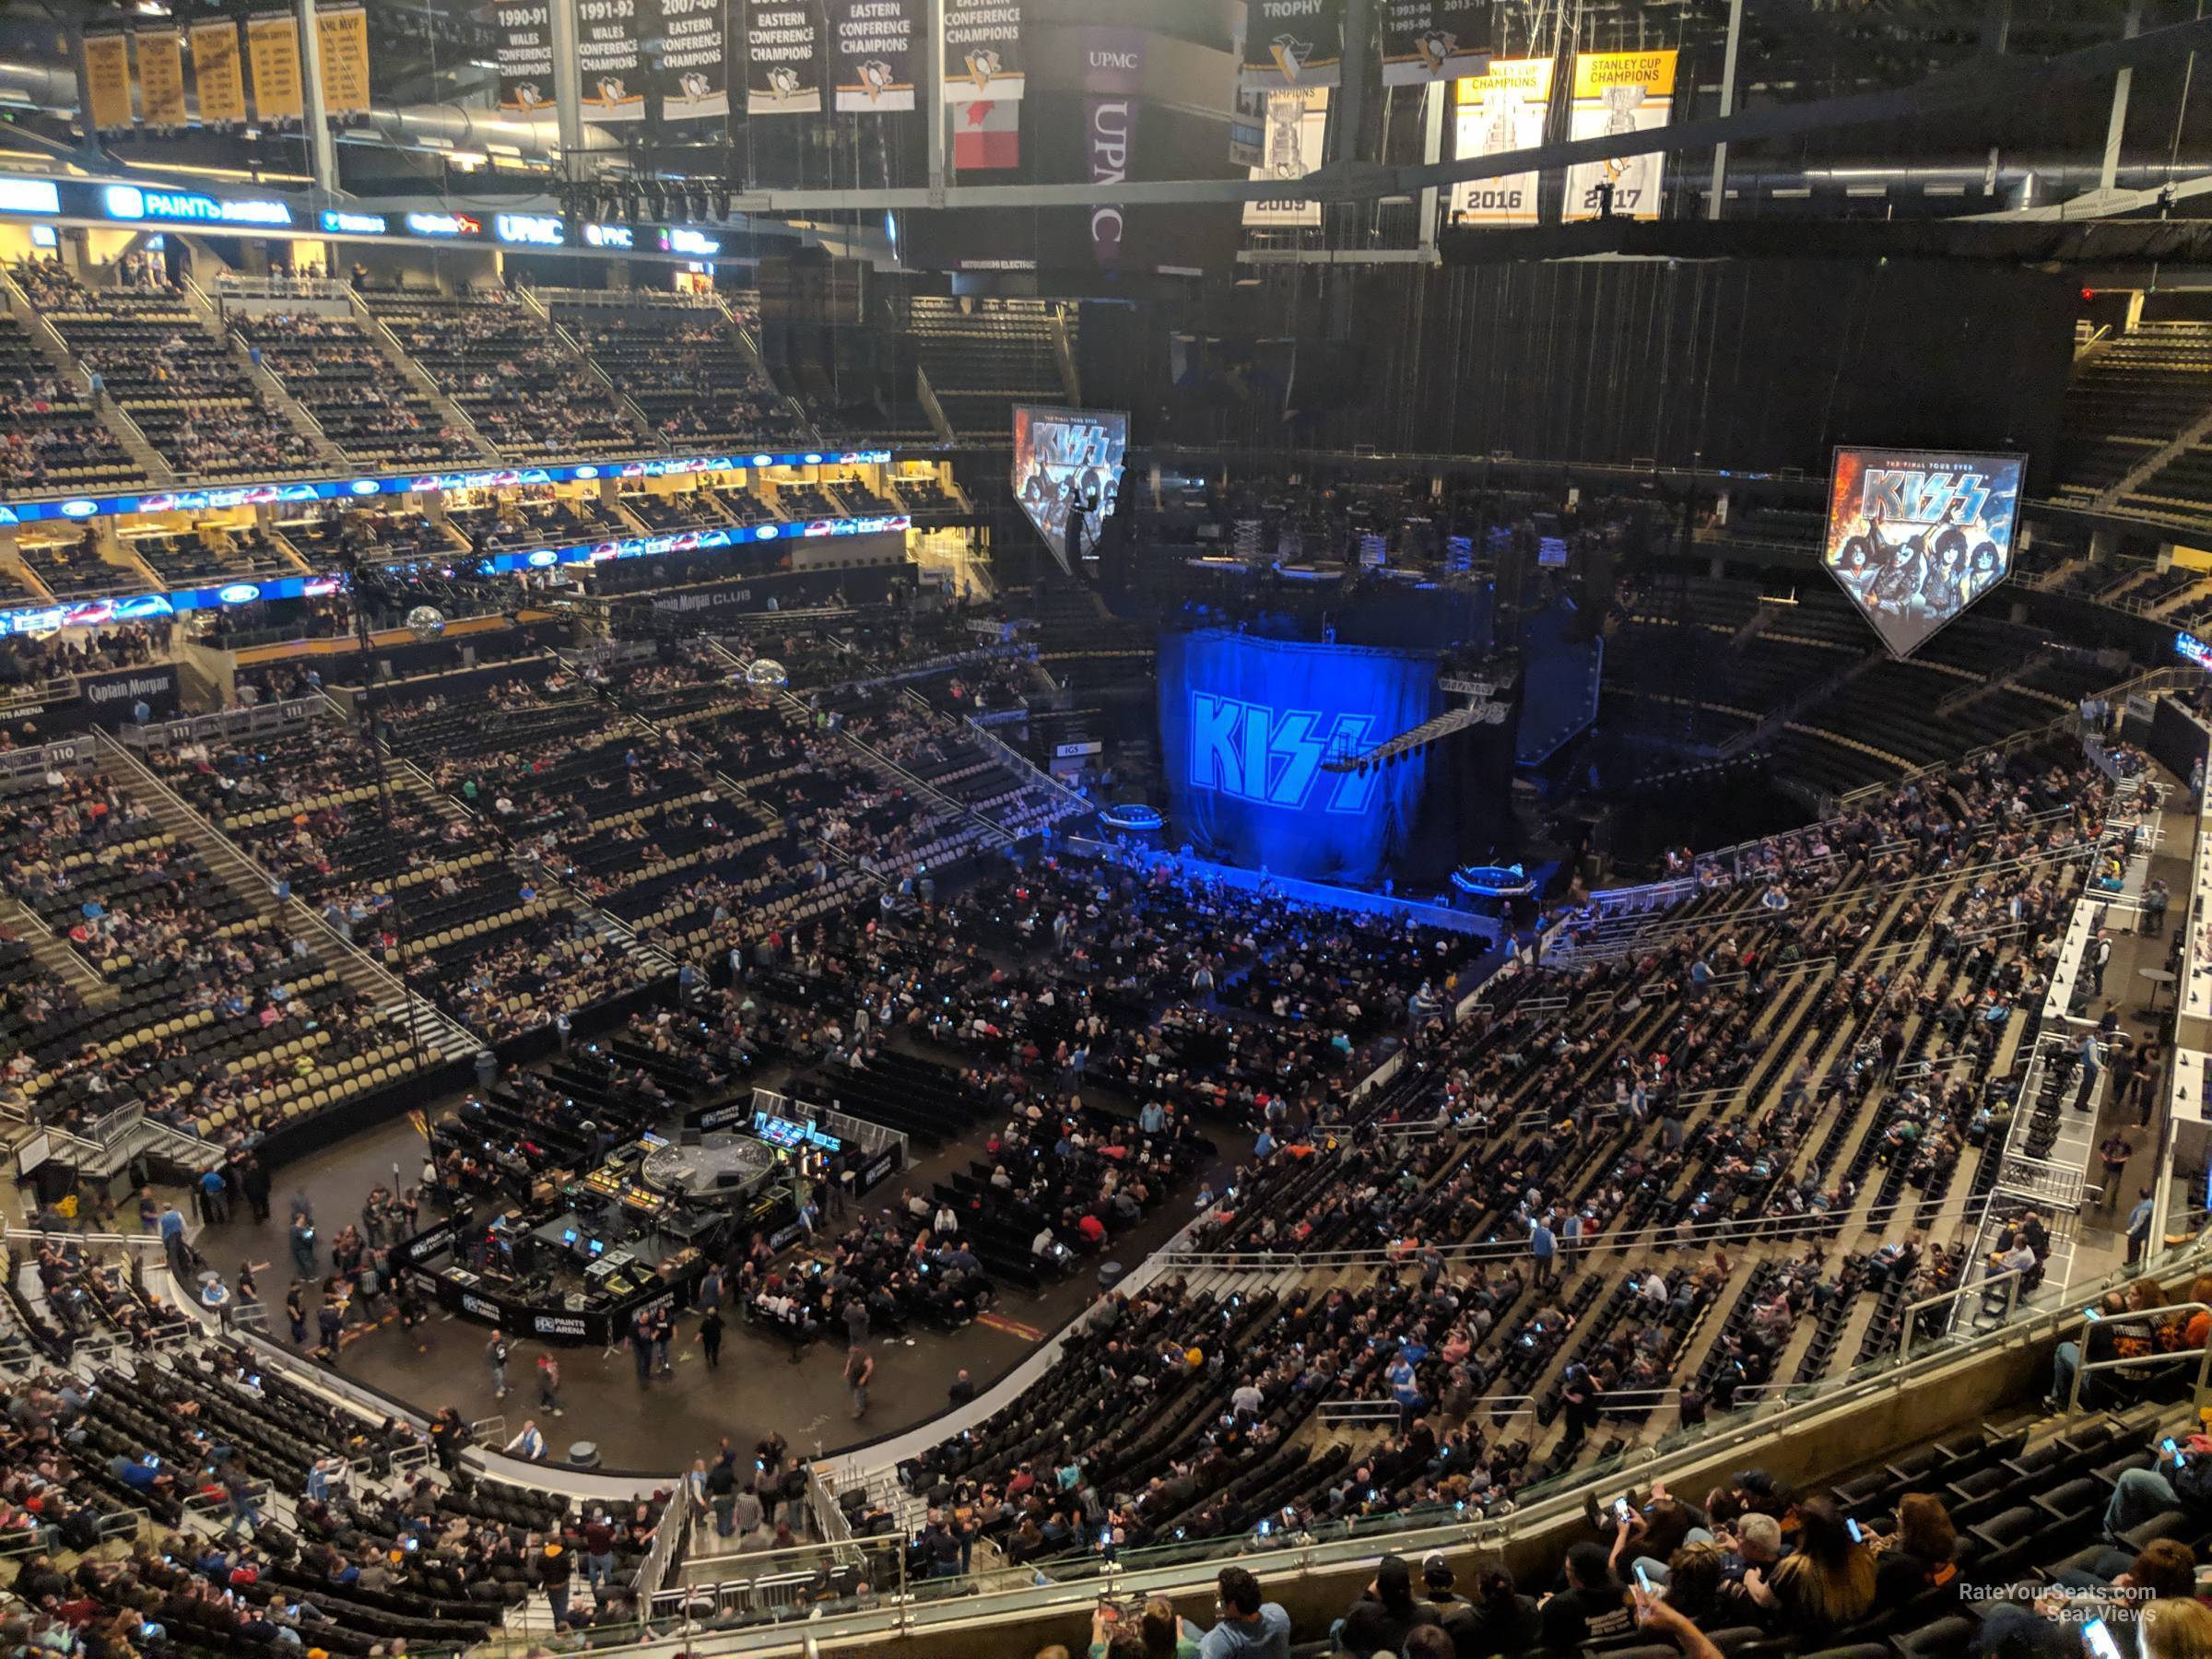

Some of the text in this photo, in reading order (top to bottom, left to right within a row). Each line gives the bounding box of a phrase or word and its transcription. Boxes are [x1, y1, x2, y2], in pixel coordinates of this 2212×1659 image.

[498, 7, 547, 27] 1990-91
[580, 1, 635, 20] 1991-92
[850, 3, 900, 18] EASTERN
[944, 7, 1020, 27] CONFERENCE
[1263, 0, 1324, 18] TROPHY
[668, 17, 713, 36] EASTERN
[758, 12, 806, 28] EASTERN
[839, 19, 911, 36] CONFERENCE
[510, 33, 539, 46] WALES
[592, 25, 624, 41] WALES
[662, 31, 722, 51] CONFERENCE
[749, 27, 814, 45] CONFERENCE
[946, 26, 1019, 44] CHAMPIONS
[579, 40, 638, 55] CONFERENCE
[751, 44, 813, 62] CHAMPIONS
[840, 37, 908, 53] CHAMPIONS
[498, 47, 552, 61] CONFERENCE
[664, 49, 722, 68] CHAMPIONS
[1089, 52, 1137, 68] UPMC
[500, 62, 551, 76] CHAMPIONS
[581, 55, 638, 71] CHAMPIONS
[1591, 58, 1661, 72] STANLEY CUP
[1472, 76, 1537, 90] CHAMPIONS
[1591, 70, 1660, 84] CHAMPIONS
[1268, 88, 1315, 100] AMPIONS
[1466, 191, 1521, 209] 2016
[1583, 189, 1641, 209] 217
[1032, 422, 1110, 467] KISS
[1862, 469, 1991, 525] KISS
[712, 590, 751, 605] CLUB
[88, 677, 169, 703] Captain Morgan
[14, 706, 44, 718] ARENA
[52, 747, 75, 760] 110
[1190, 690, 1383, 814] KISS
[555, 1318, 585, 1327] PAINTS
[555, 1326, 585, 1335] ARENA
